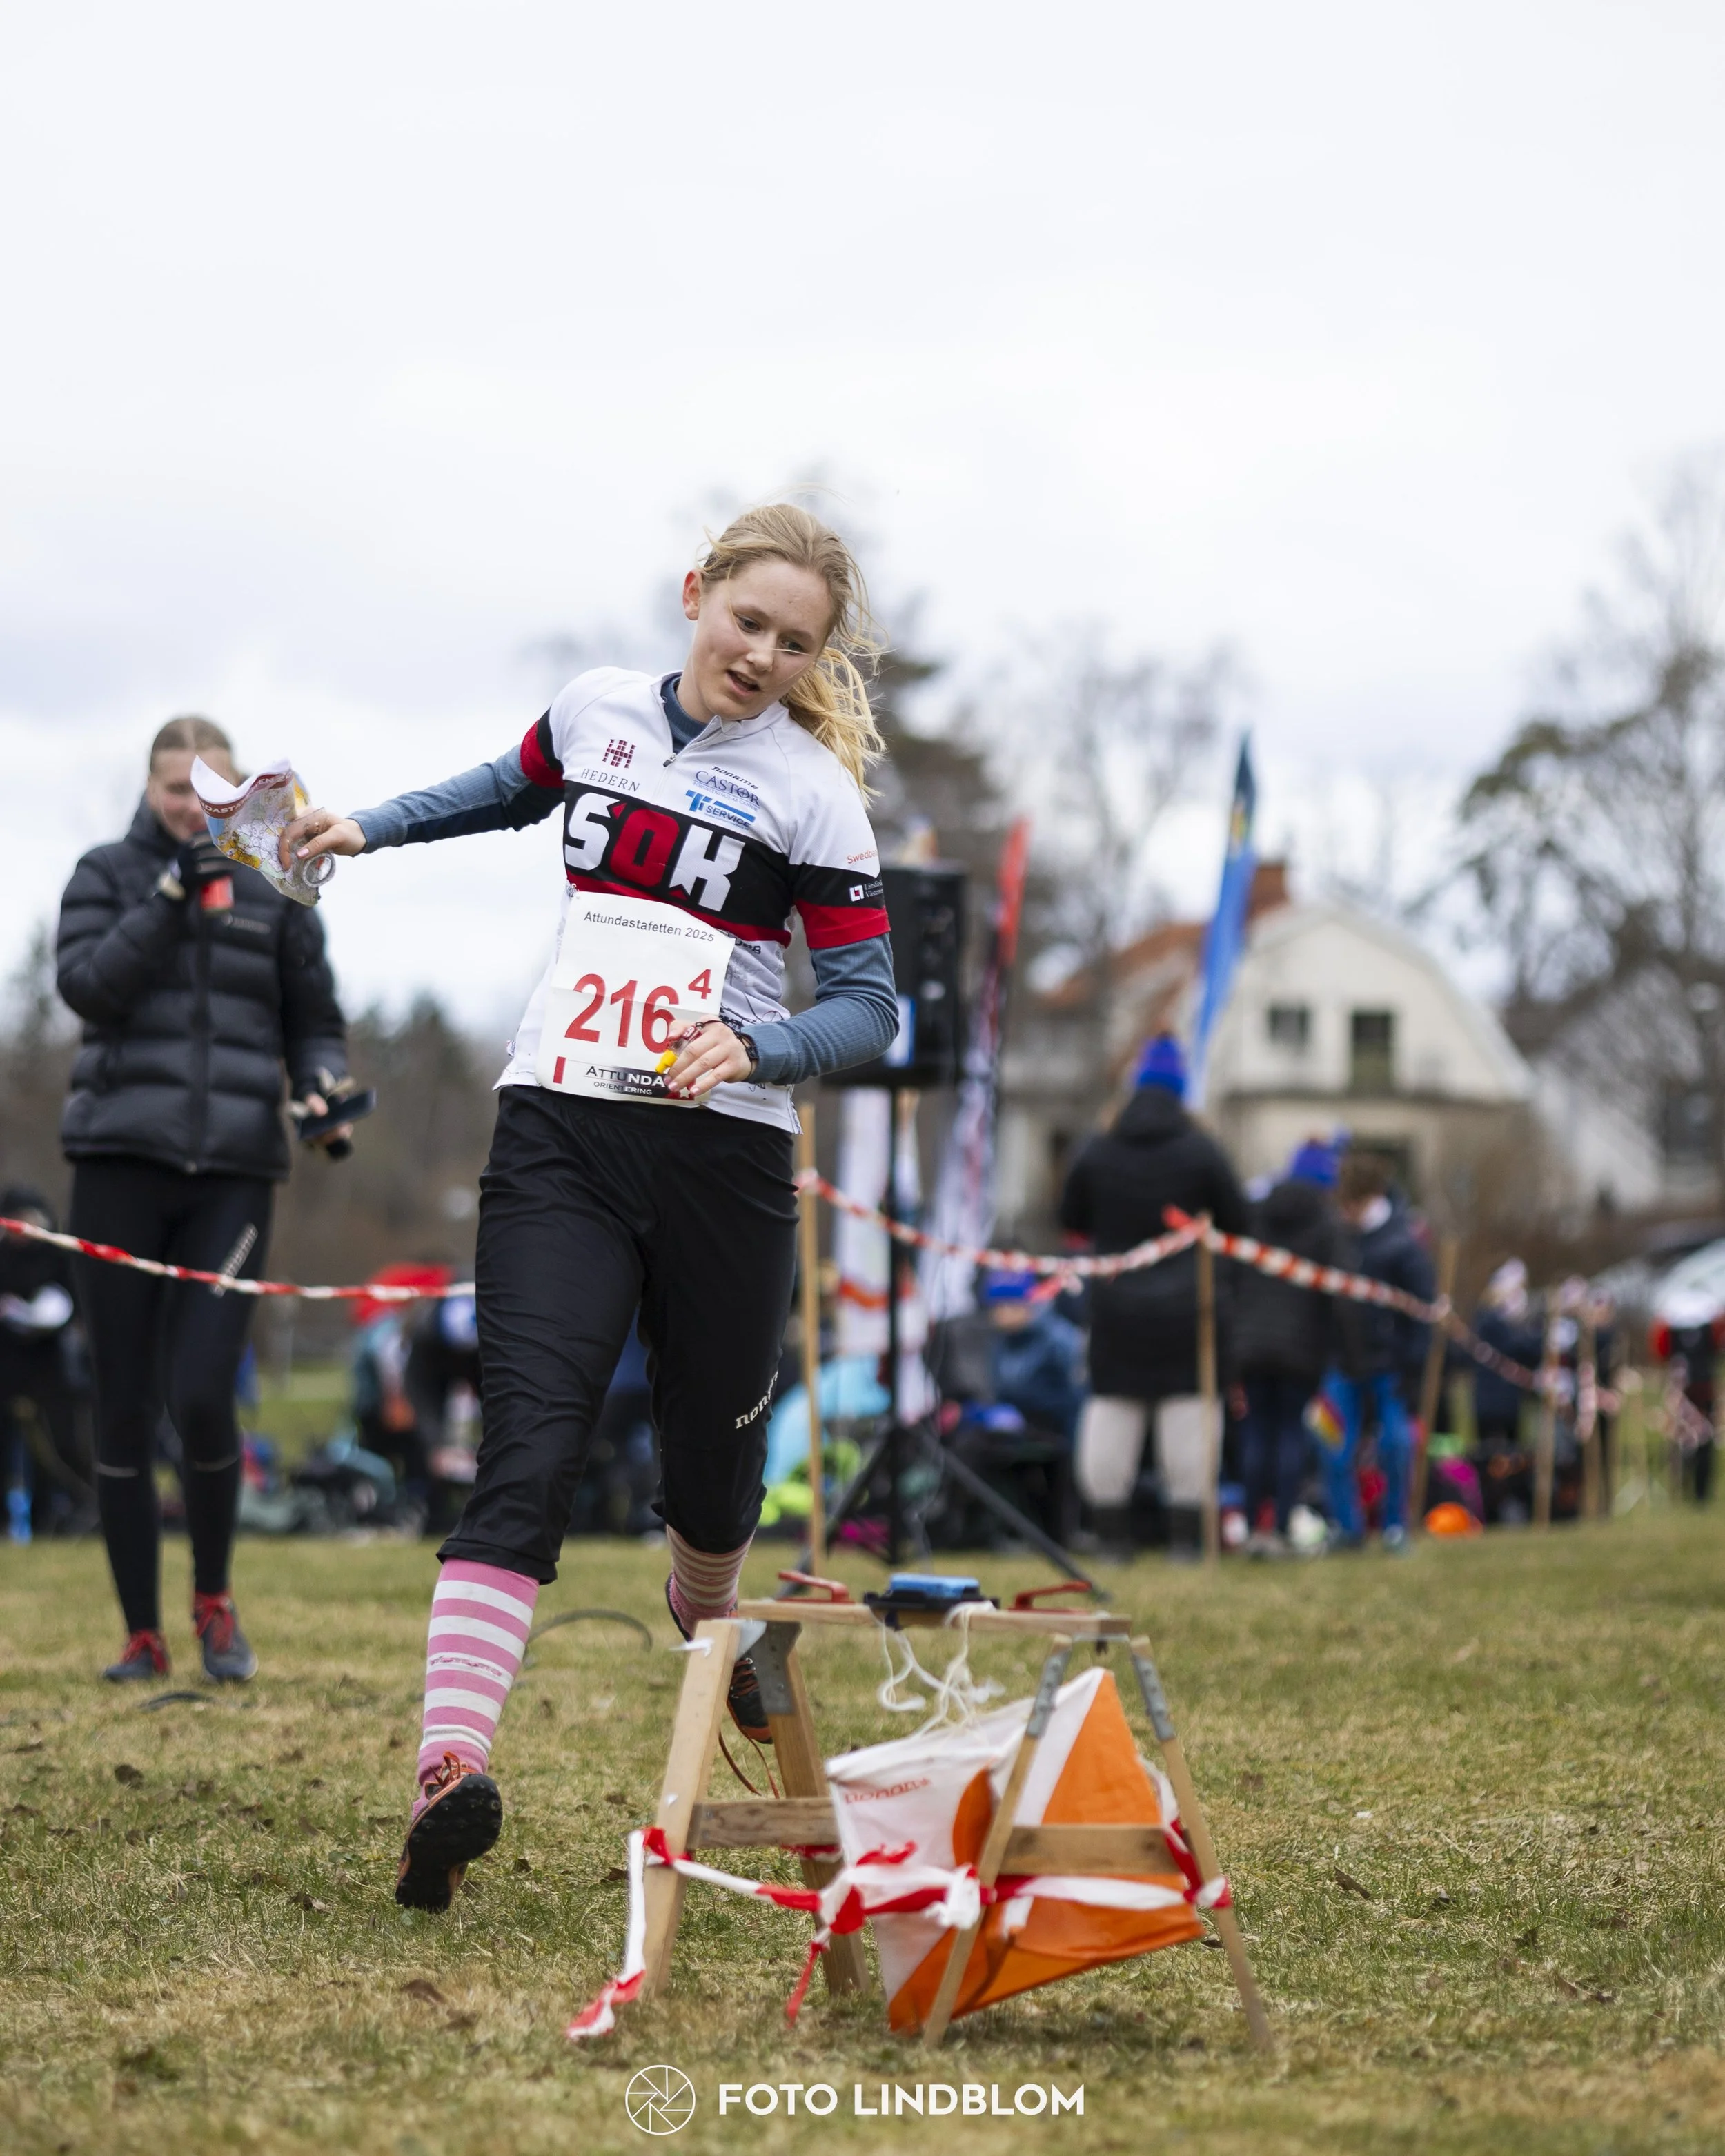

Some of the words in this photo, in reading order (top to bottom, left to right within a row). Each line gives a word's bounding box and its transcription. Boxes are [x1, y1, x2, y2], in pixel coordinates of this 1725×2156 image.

[581, 768, 640, 792] HEDERN
[696, 771, 760, 806] CASTOR
[711, 766, 758, 789] noname
[706, 805, 751, 828] SERVICE
[564, 792, 746, 912] SOK
[847, 849, 878, 864] Swedba
[584, 911, 682, 936] Attundastafetten
[684, 927, 715, 942] 2025
[688, 969, 712, 999] 4
[564, 973, 680, 1054] 216
[593, 1081, 653, 1096] ORIENTERING
